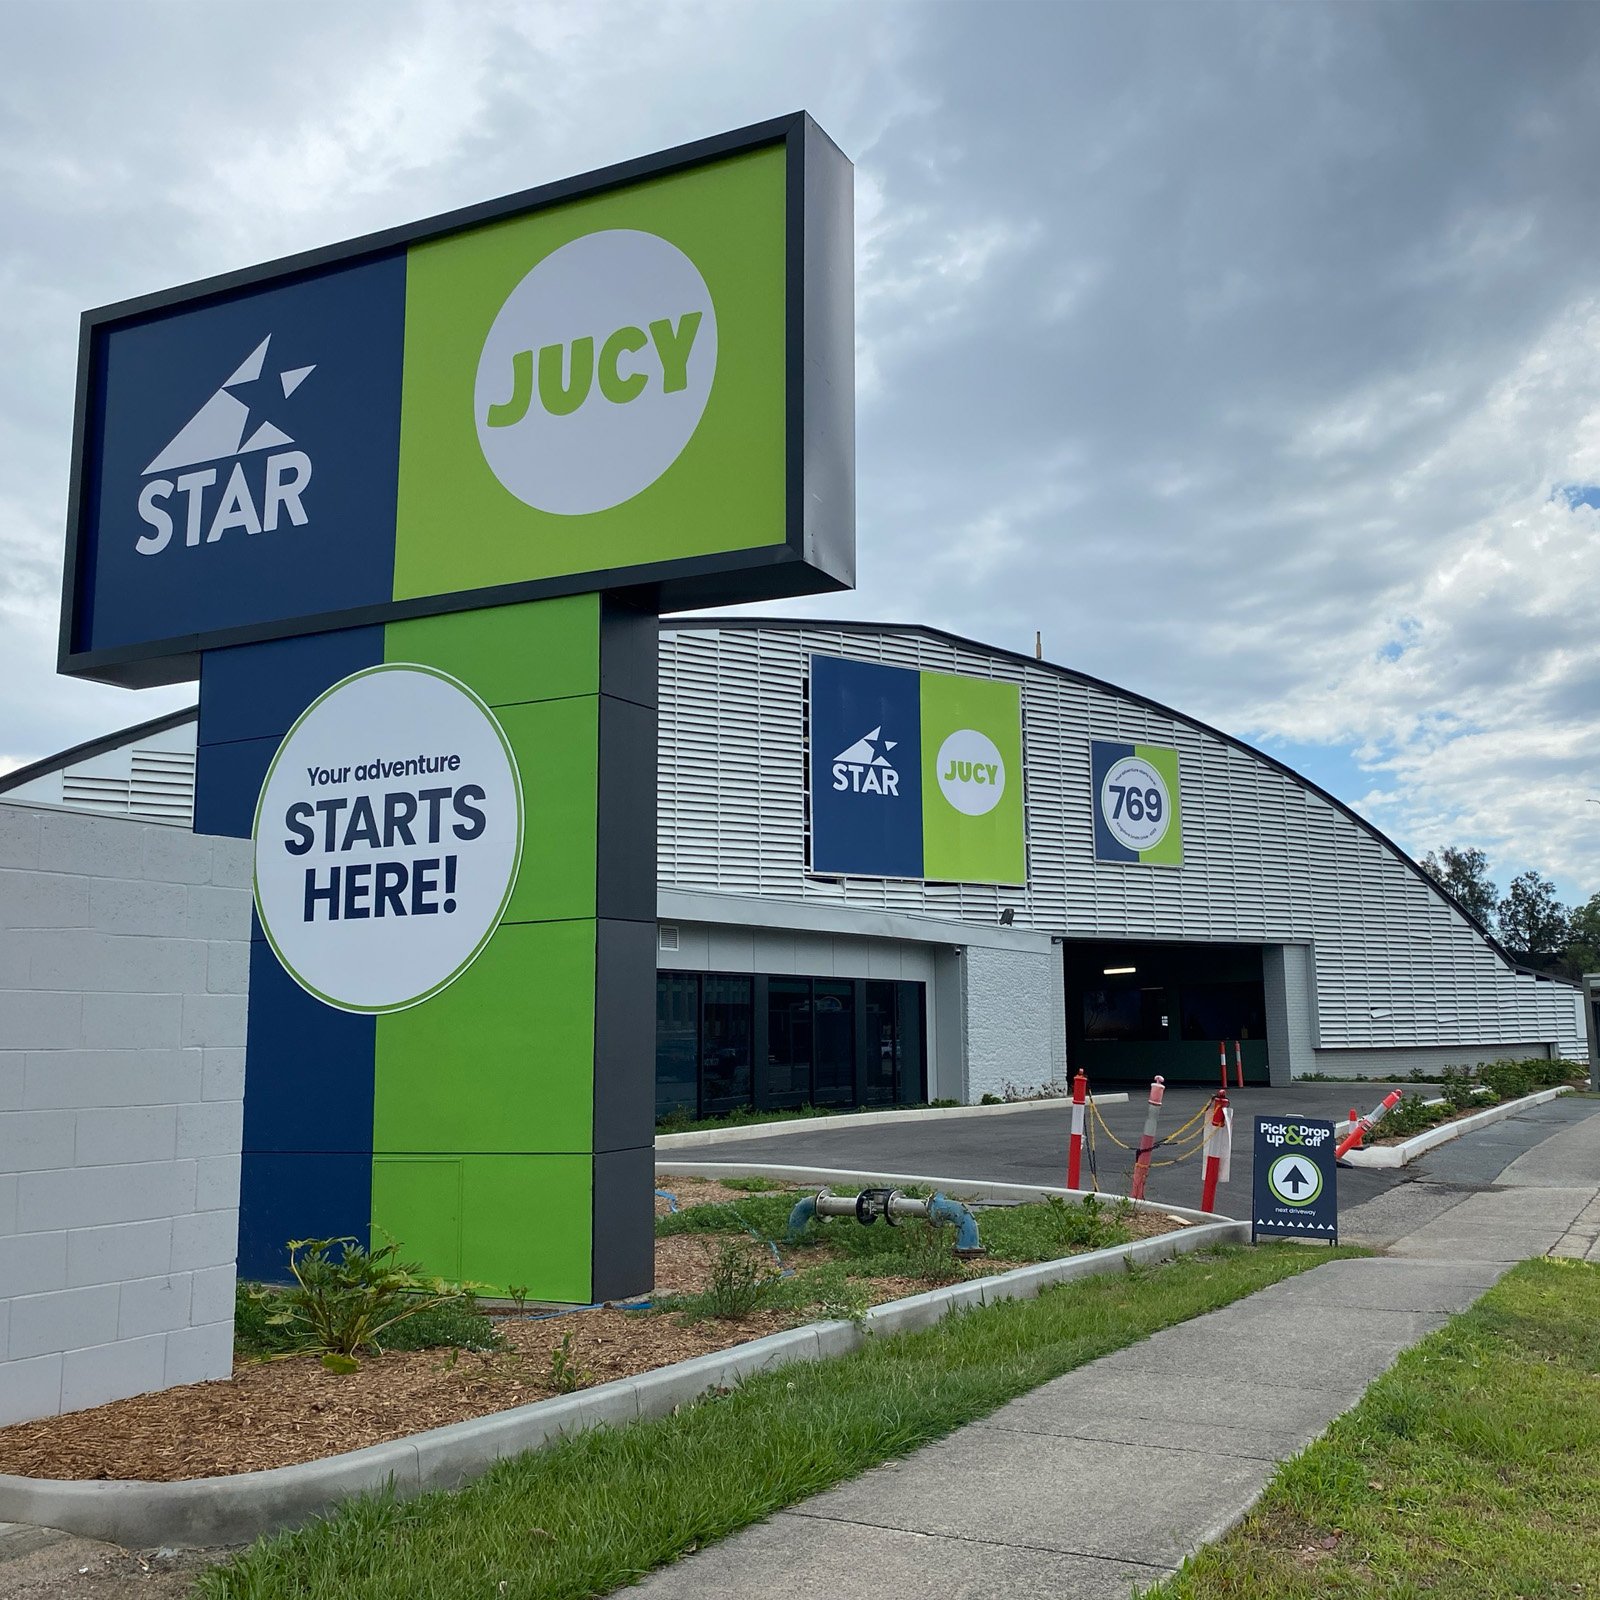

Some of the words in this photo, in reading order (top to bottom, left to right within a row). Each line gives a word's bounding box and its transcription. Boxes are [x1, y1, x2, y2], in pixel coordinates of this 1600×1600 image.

[486, 312, 702, 428] JUCY
[136, 450, 312, 556] STAR
[307, 766, 352, 787] Your
[354, 754, 461, 782] adventure
[832, 763, 899, 797] STAR
[944, 760, 998, 785] JUCY
[284, 784, 487, 856] STARTS
[1108, 784, 1163, 823] 769
[303, 854, 458, 922] HERE!
[1260, 1122, 1287, 1134] Pick
[1285, 1125, 1305, 1146] &
[1299, 1125, 1330, 1141] Drop
[1266, 1135, 1284, 1147] up
[1304, 1136, 1322, 1147] off
[1289, 1208, 1317, 1217] driveway
